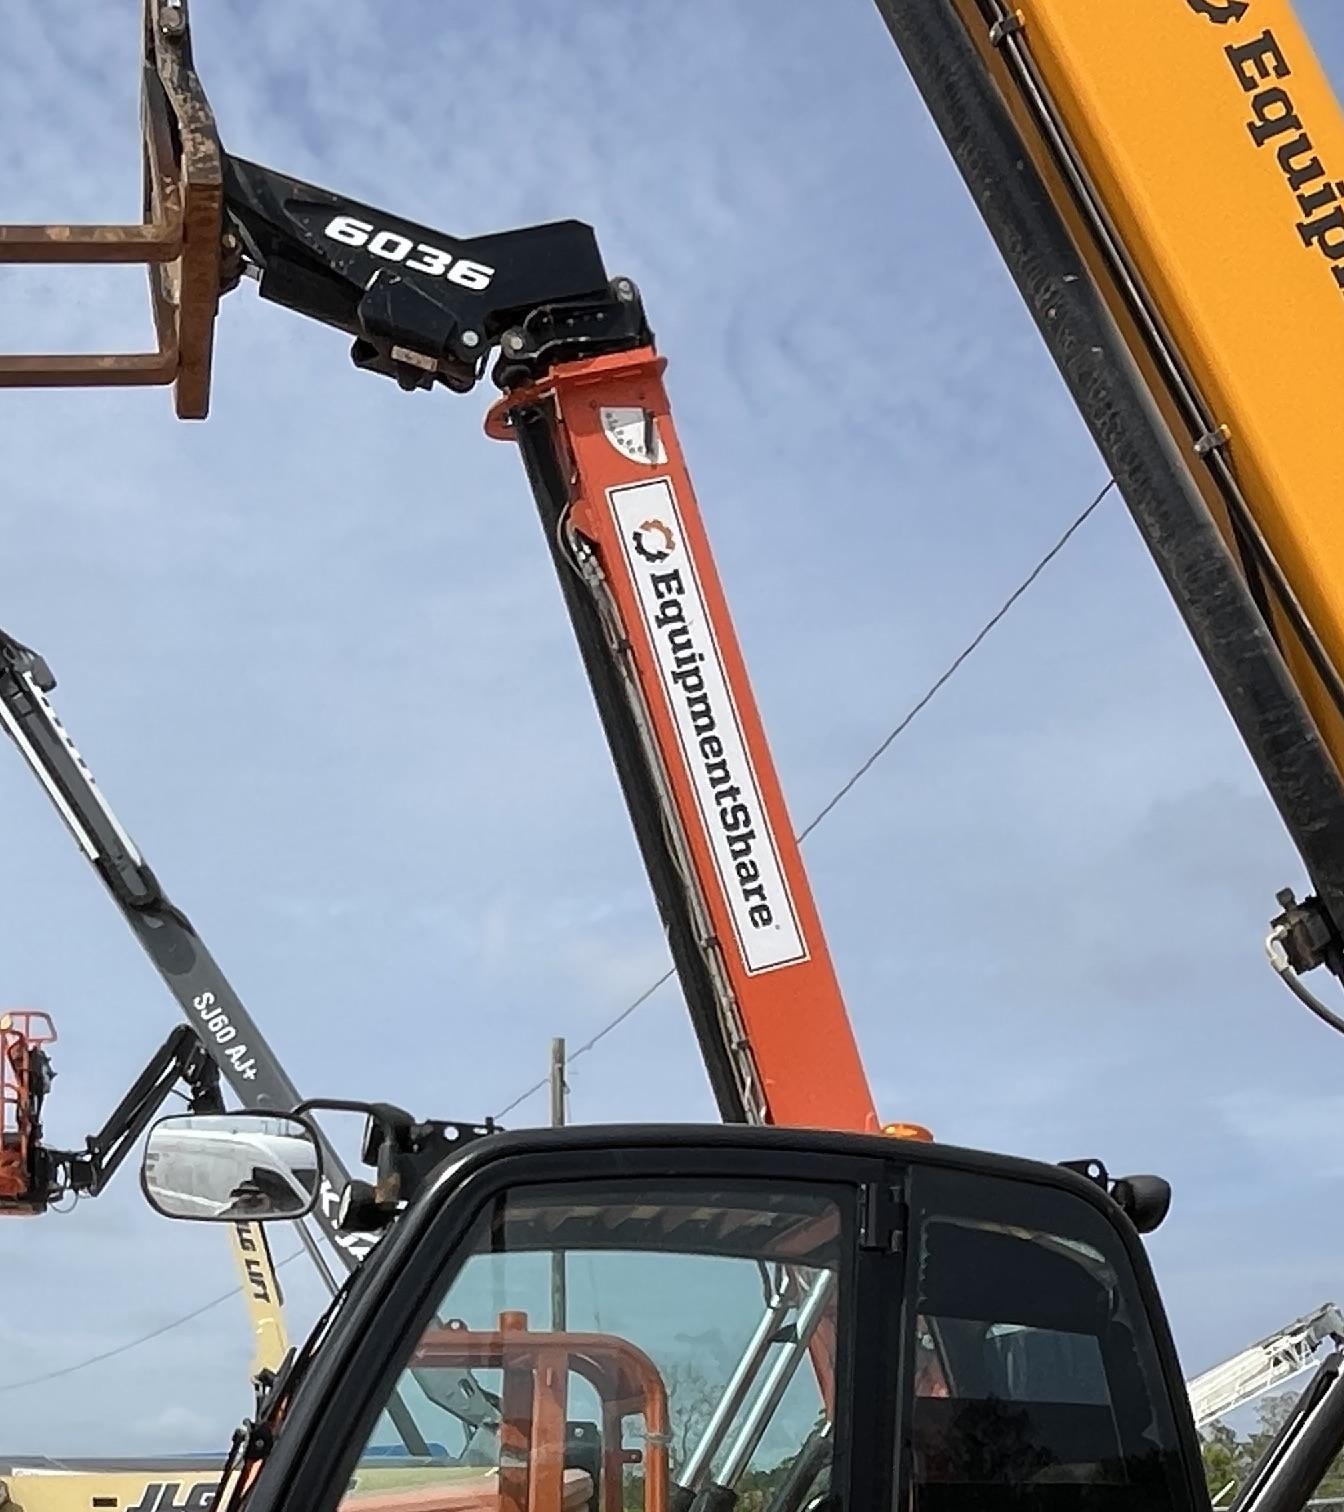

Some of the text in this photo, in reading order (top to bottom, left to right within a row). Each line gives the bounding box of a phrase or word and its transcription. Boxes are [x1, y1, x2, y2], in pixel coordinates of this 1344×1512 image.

[324, 215, 496, 291] 6036
[193, 991, 257, 1080] SJ60 AJ+
